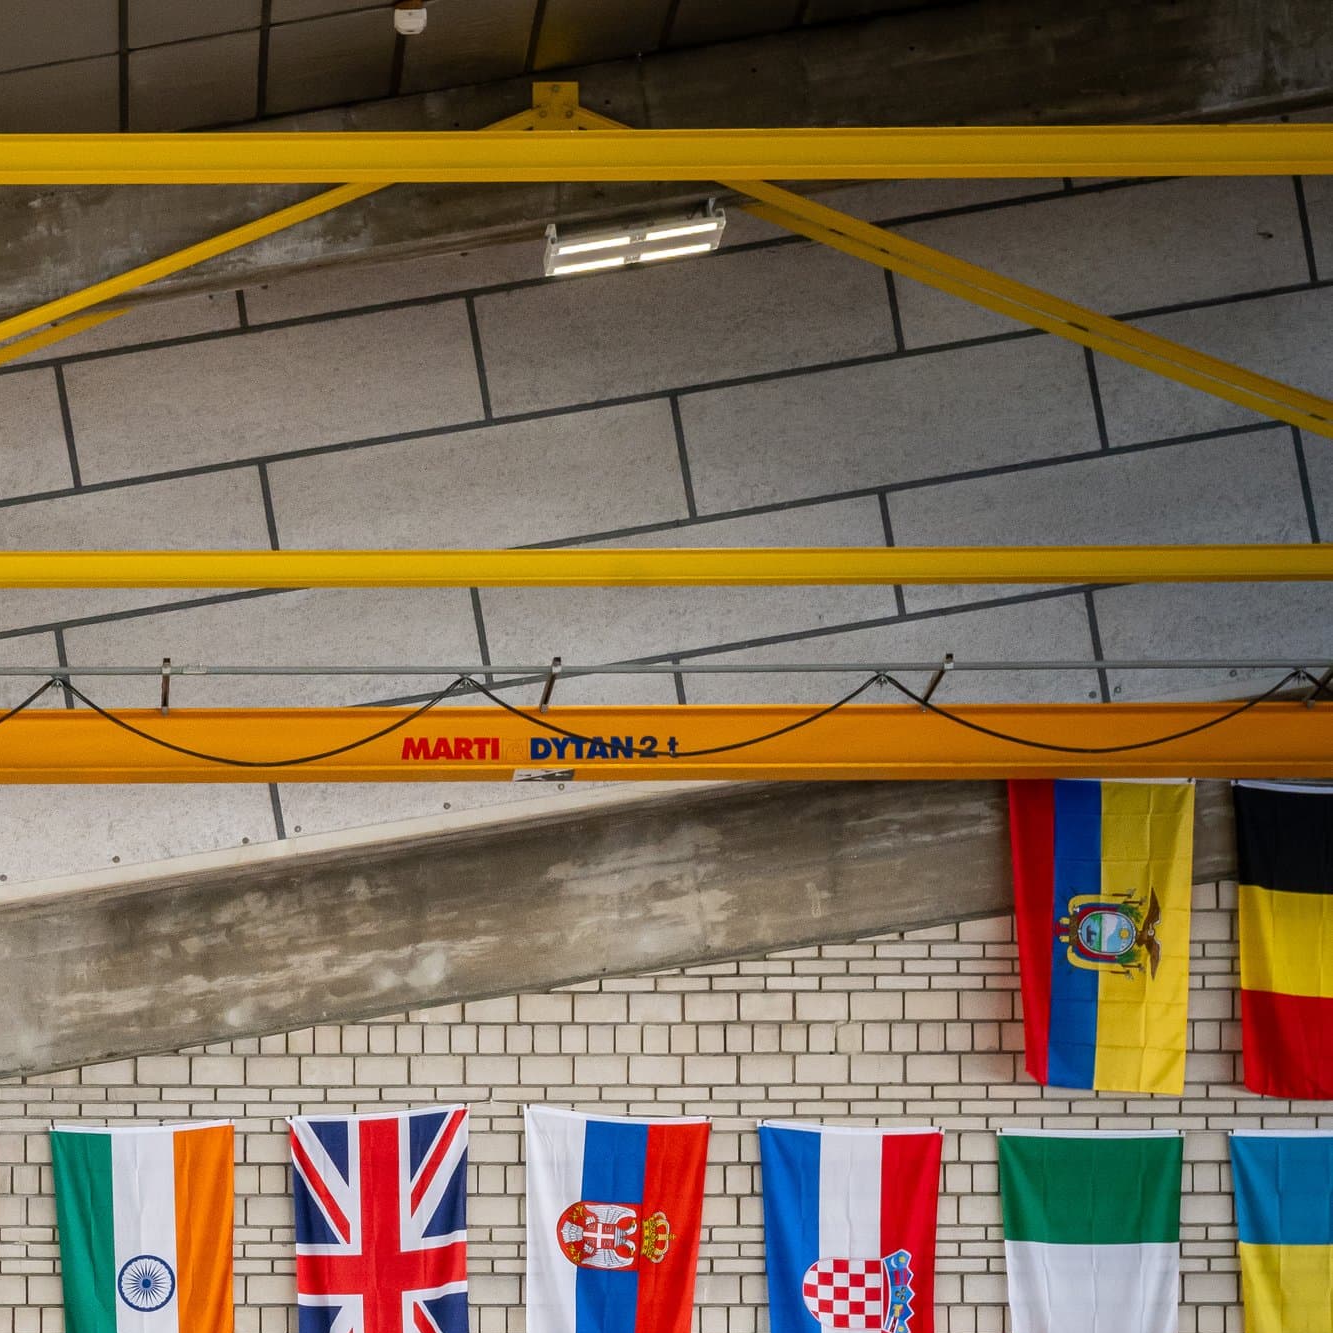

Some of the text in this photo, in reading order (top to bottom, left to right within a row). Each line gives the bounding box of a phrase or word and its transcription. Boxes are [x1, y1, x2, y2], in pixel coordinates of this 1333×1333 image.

[402, 737, 500, 760] MARTI
[530, 736, 633, 760] DYTAN
[639, 735, 659, 759] 2
